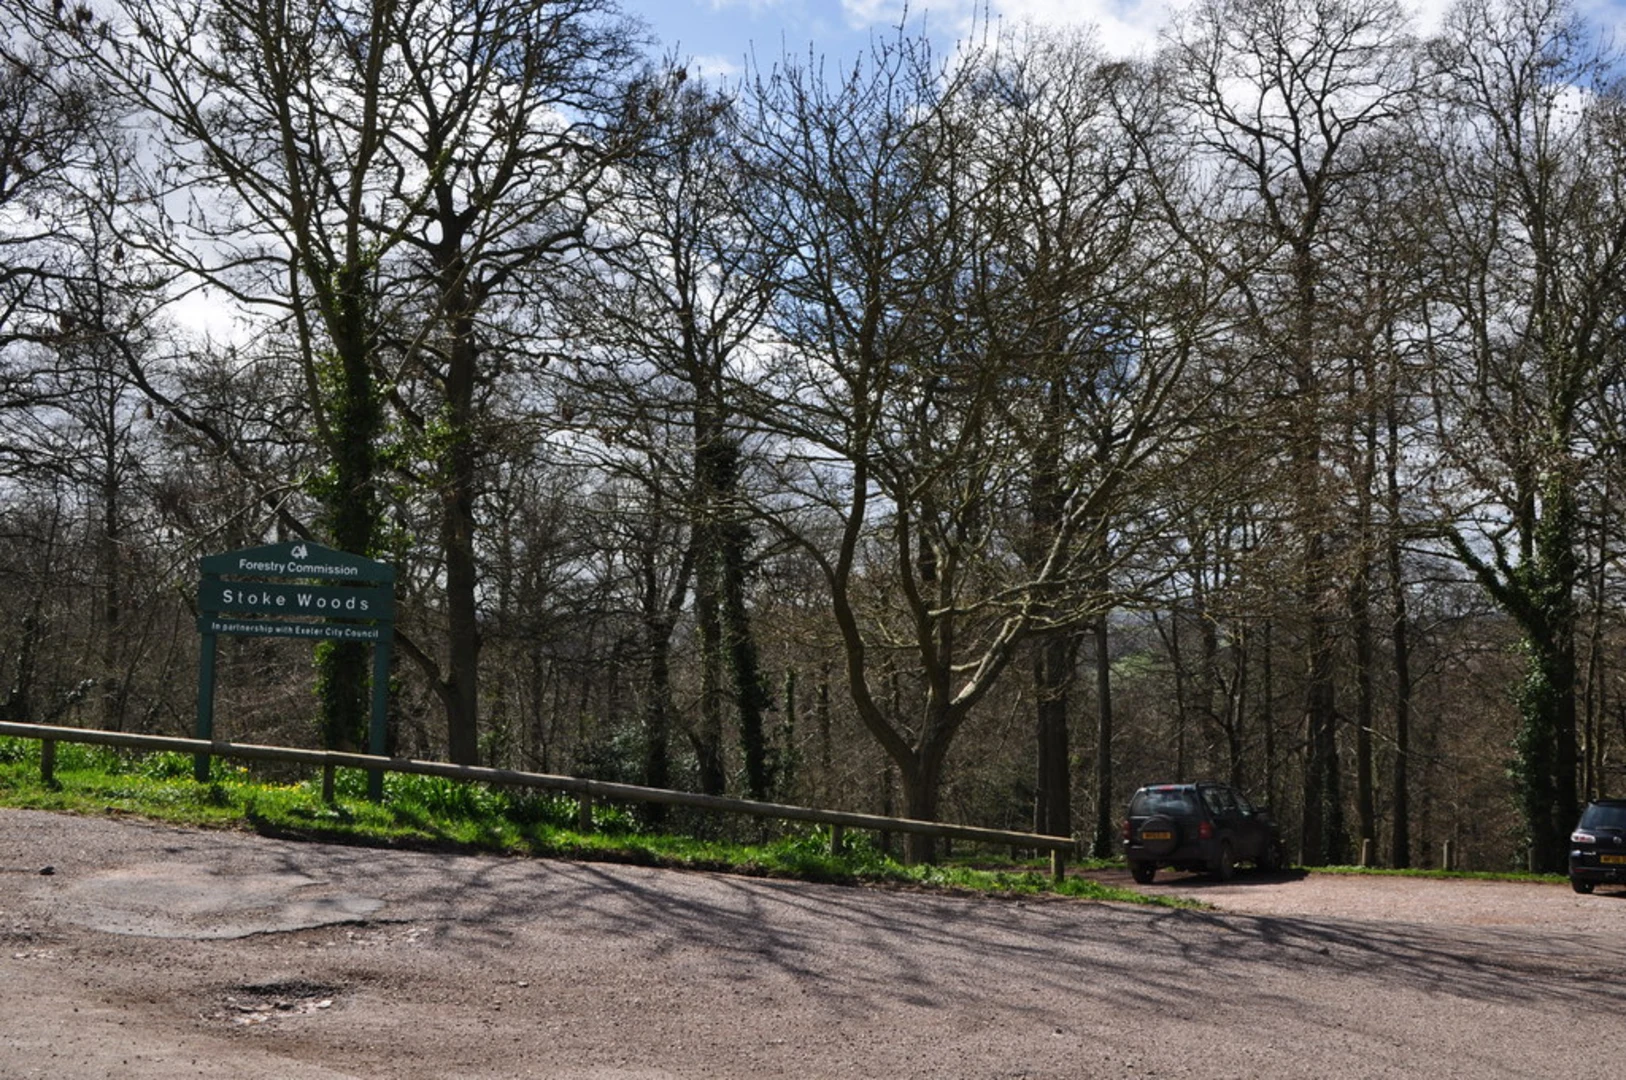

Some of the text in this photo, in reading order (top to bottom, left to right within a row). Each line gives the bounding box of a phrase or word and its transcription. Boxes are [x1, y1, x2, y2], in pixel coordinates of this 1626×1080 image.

[239, 559, 358, 575] Forestry Commission
[223, 589, 369, 610] Stoke Woods
[211, 622, 379, 638] In partnership with Exeter City Council
